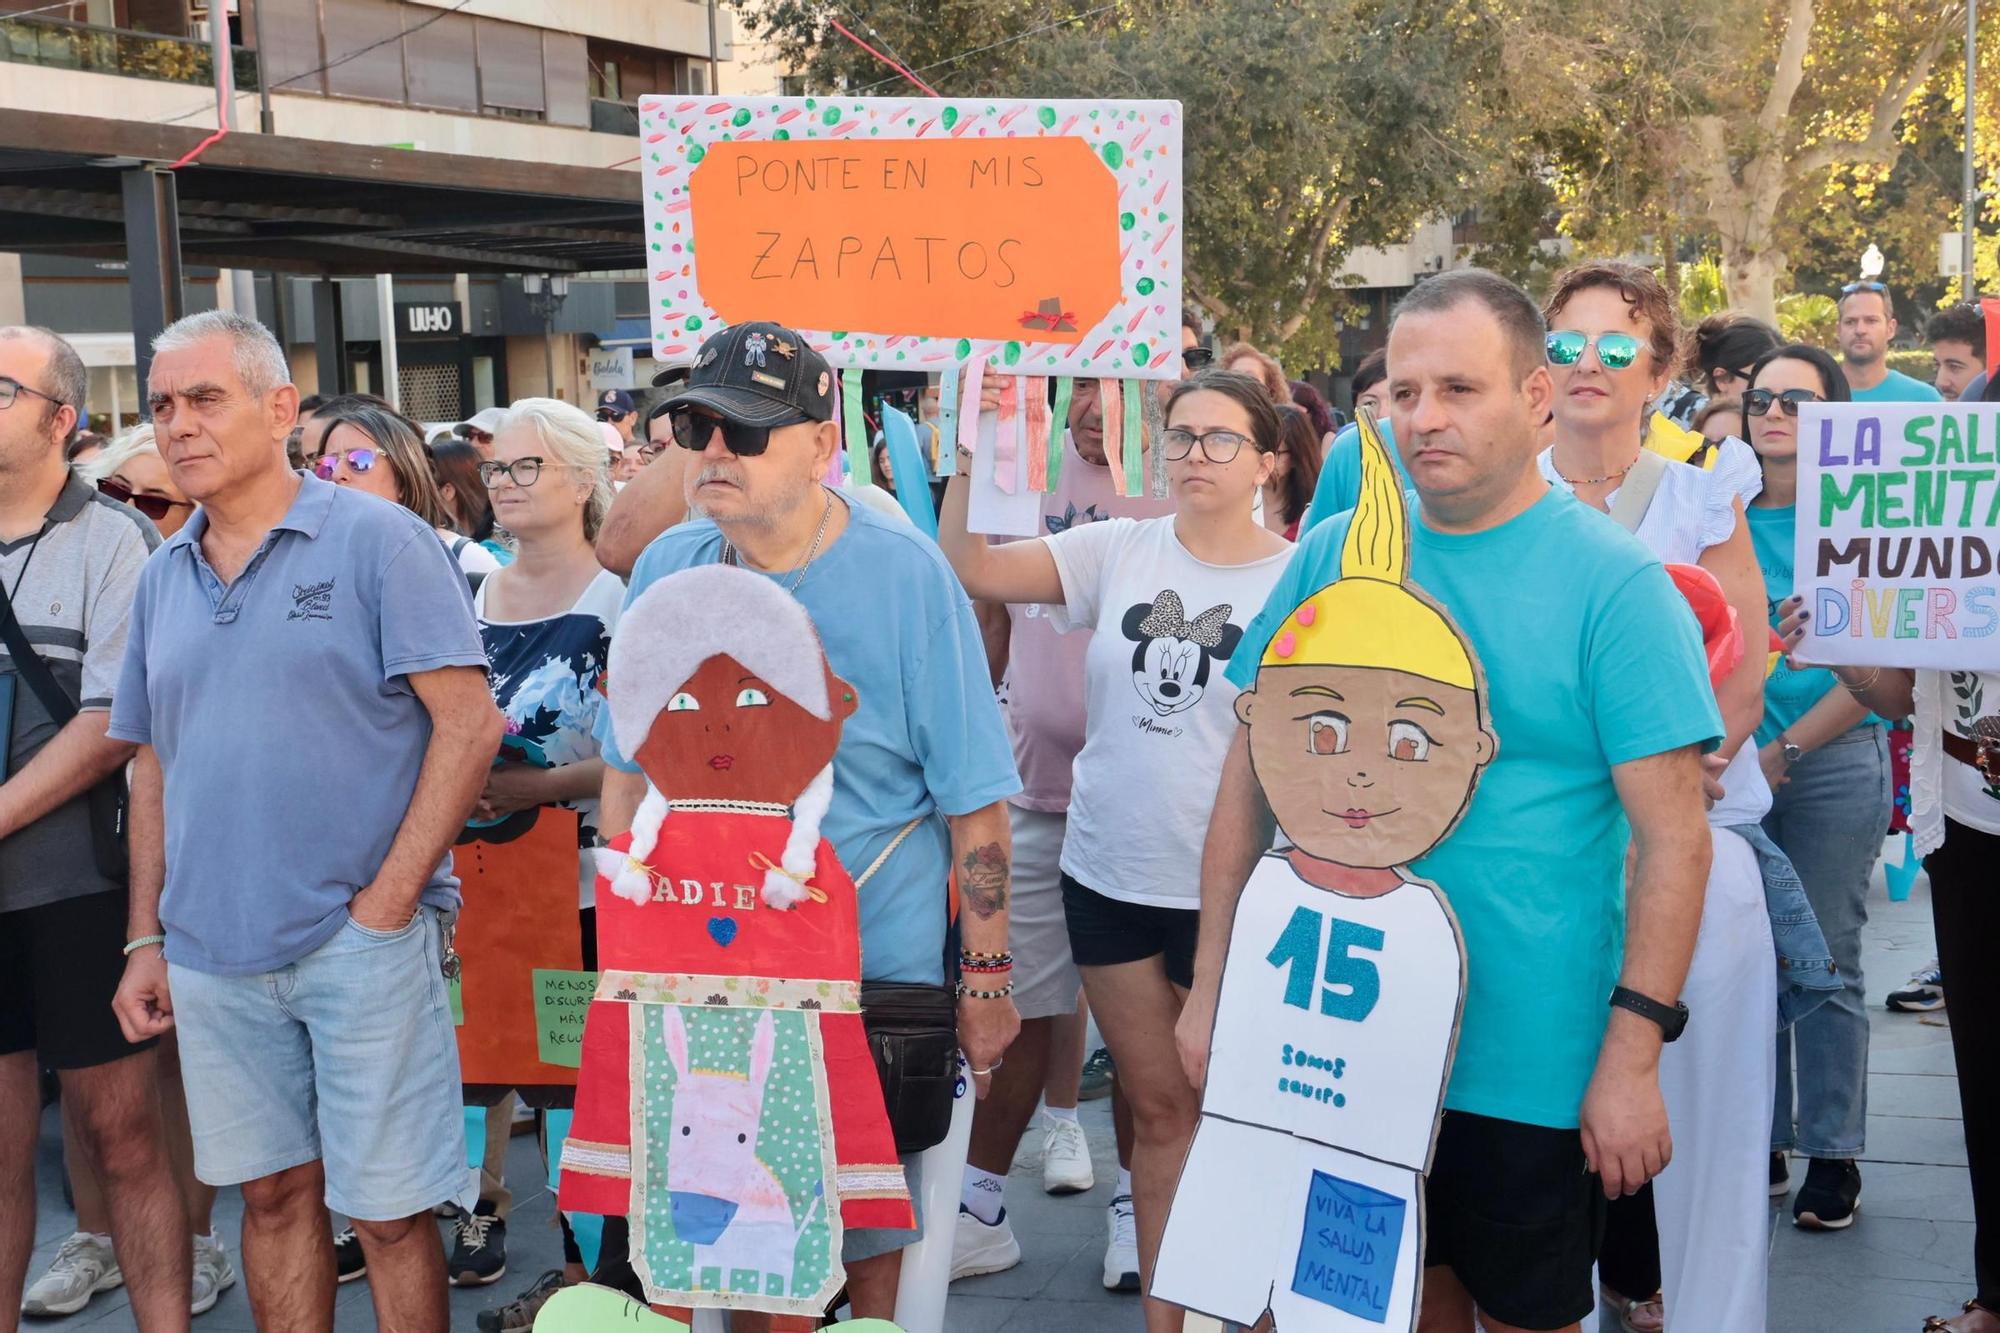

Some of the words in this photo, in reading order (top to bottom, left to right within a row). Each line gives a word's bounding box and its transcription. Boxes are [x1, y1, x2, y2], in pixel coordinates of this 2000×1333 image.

[736, 155, 861, 196] PONTE
[883, 157, 926, 190] EN
[970, 156, 1044, 189] MIS
[750, 231, 1022, 288] ZAPATOS
[1818, 416, 1882, 467] LA
[1900, 412, 2000, 466] SAL
[1816, 536, 2000, 579] MUND
[1138, 717, 1173, 736] Minnie
[1265, 904, 1386, 1023] 15
[546, 979, 596, 992] MENOS
[560, 1010, 585, 1024] MÁS
[1316, 1195, 1356, 1225] VIVA
[1365, 1213, 1387, 1237] LA
[1318, 1227, 1375, 1265] SALUD
[1303, 1260, 1384, 1310] MENTAL
